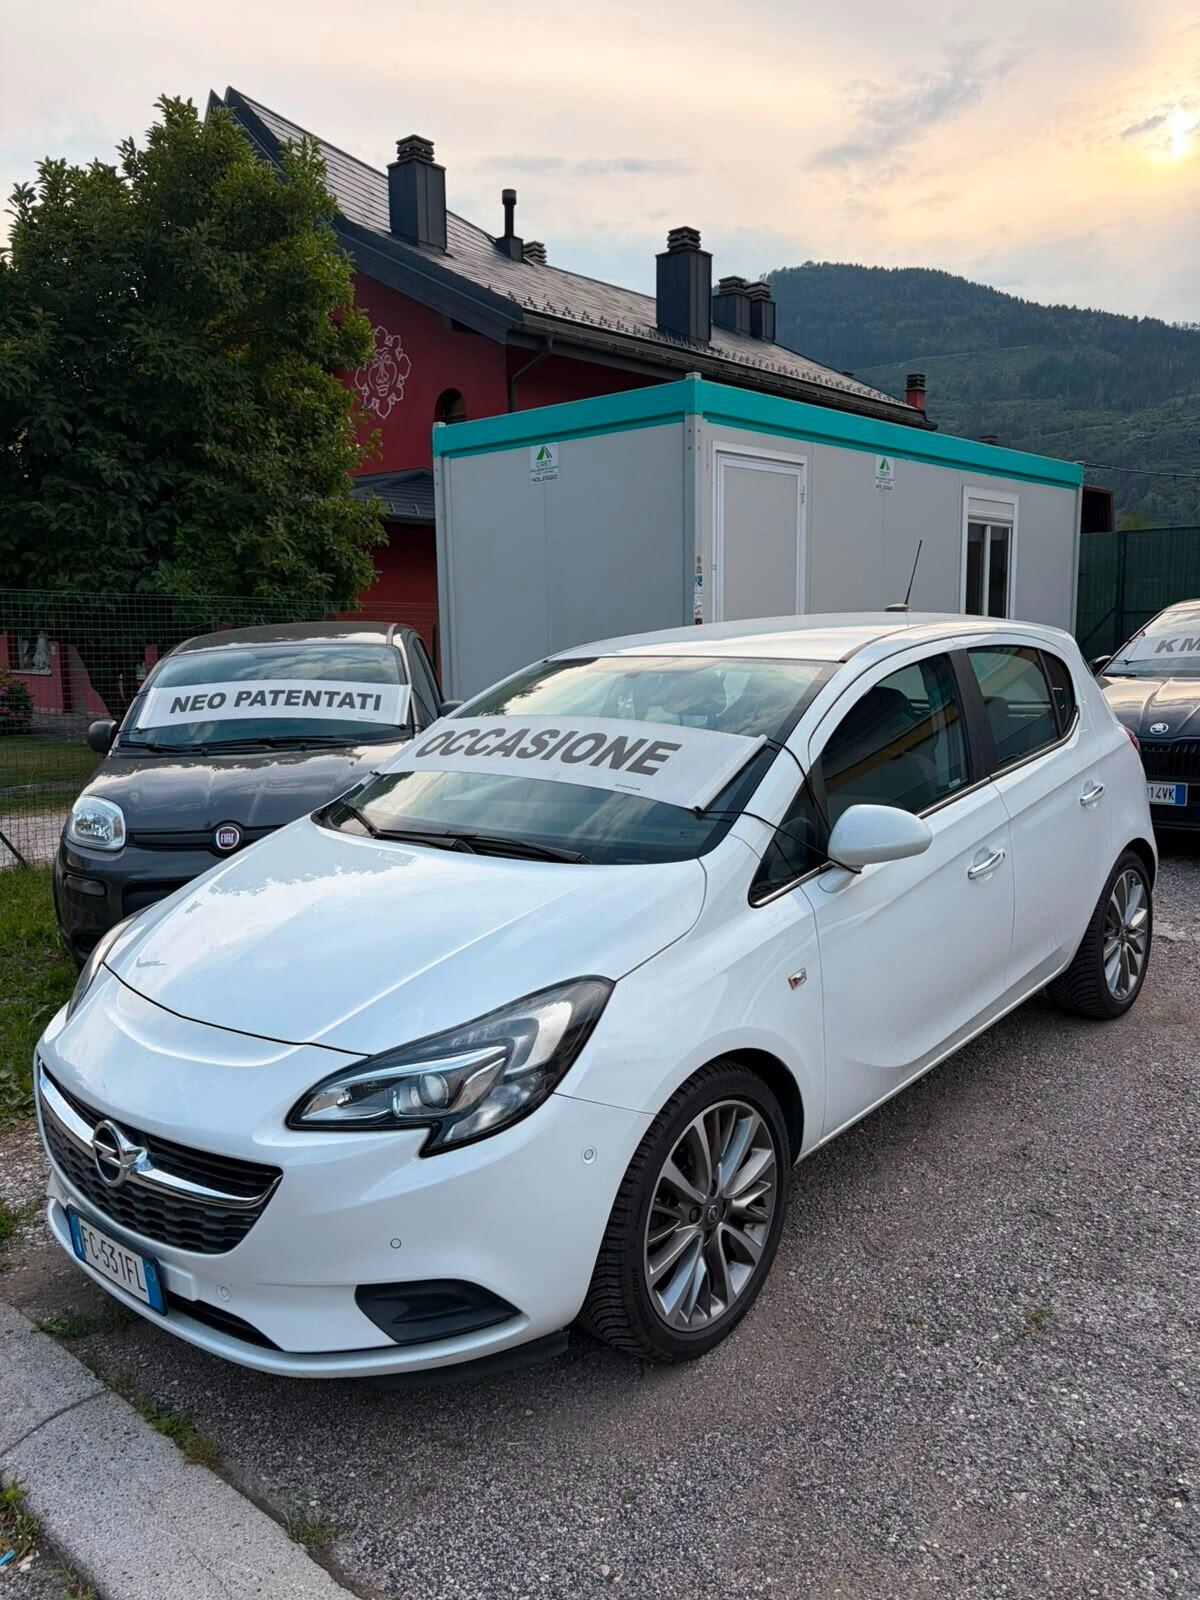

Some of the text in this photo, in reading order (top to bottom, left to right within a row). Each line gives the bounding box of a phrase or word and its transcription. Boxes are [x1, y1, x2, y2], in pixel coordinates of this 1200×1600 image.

[1154, 637, 1200, 654] KM
[169, 689, 382, 714] NEO PATENTATI
[415, 727, 683, 777] OCCASIONE
[1147, 785, 1176, 801] 14VK
